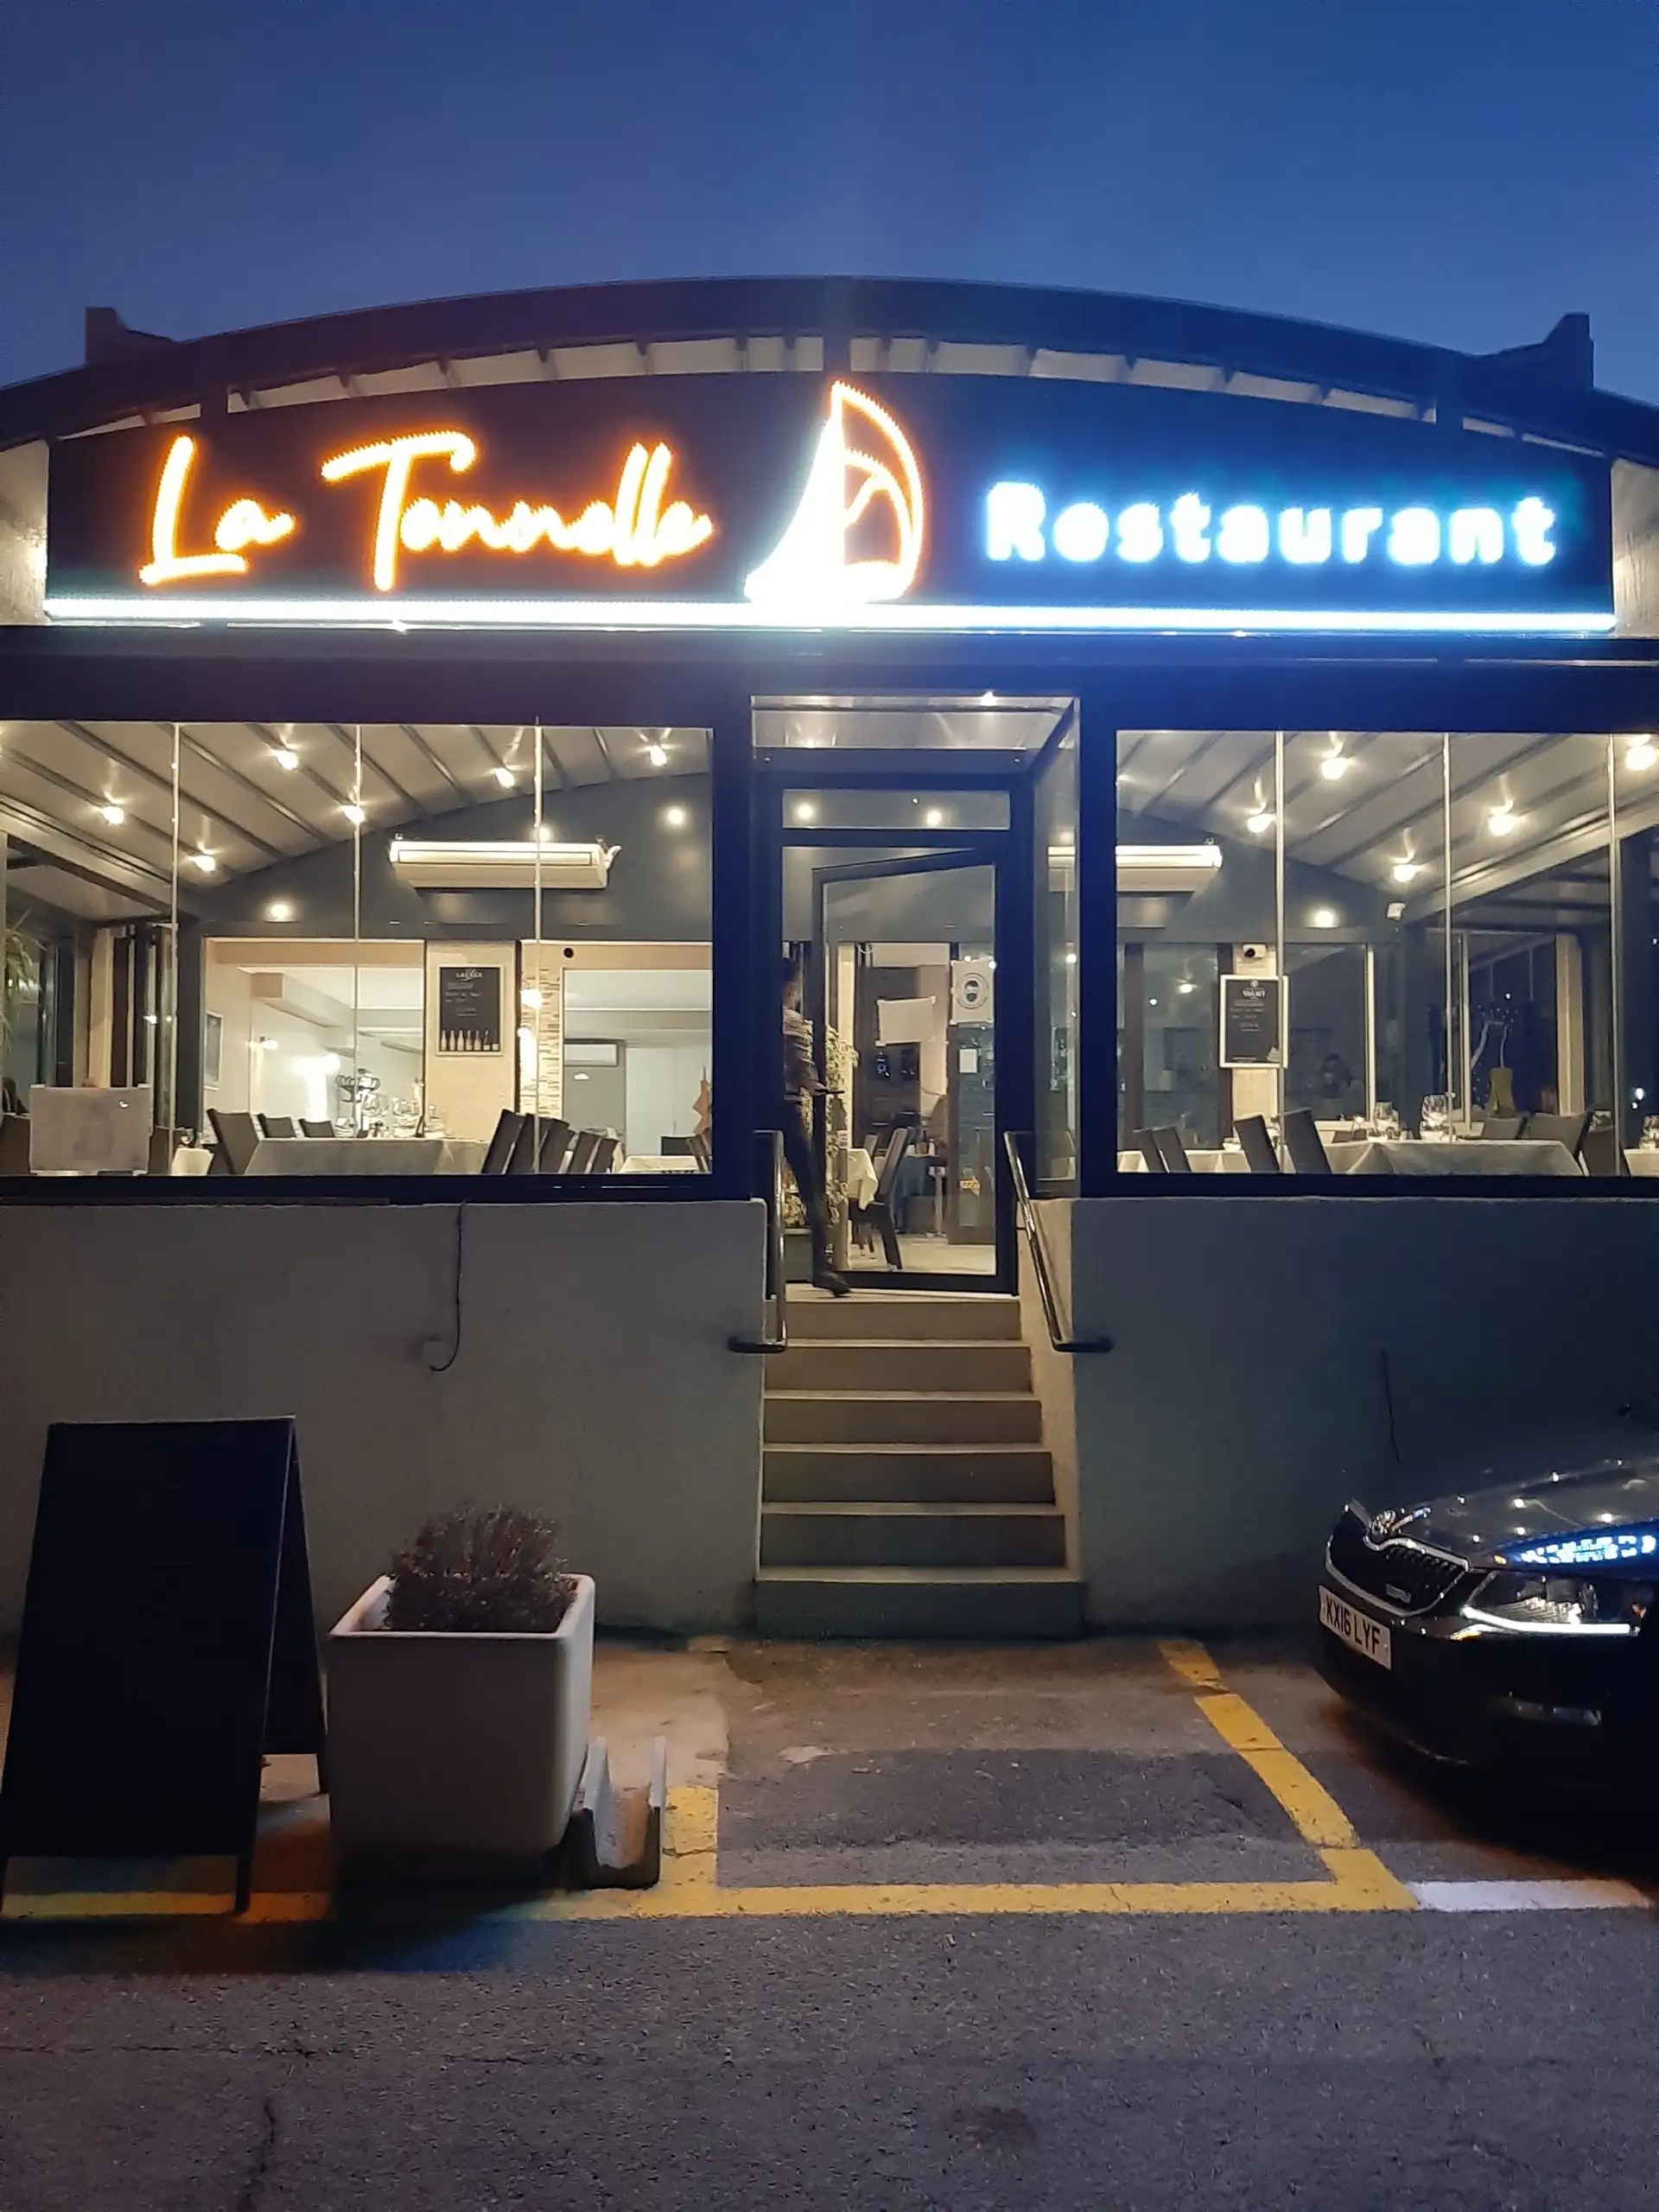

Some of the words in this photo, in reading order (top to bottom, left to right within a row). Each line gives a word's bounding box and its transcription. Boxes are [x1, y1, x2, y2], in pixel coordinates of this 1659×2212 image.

[138, 435, 296, 588] La
[985, 480, 1557, 566] Restaurant
[1325, 1594, 1351, 1637] KX16
[1354, 1613, 1381, 1655] LYF
